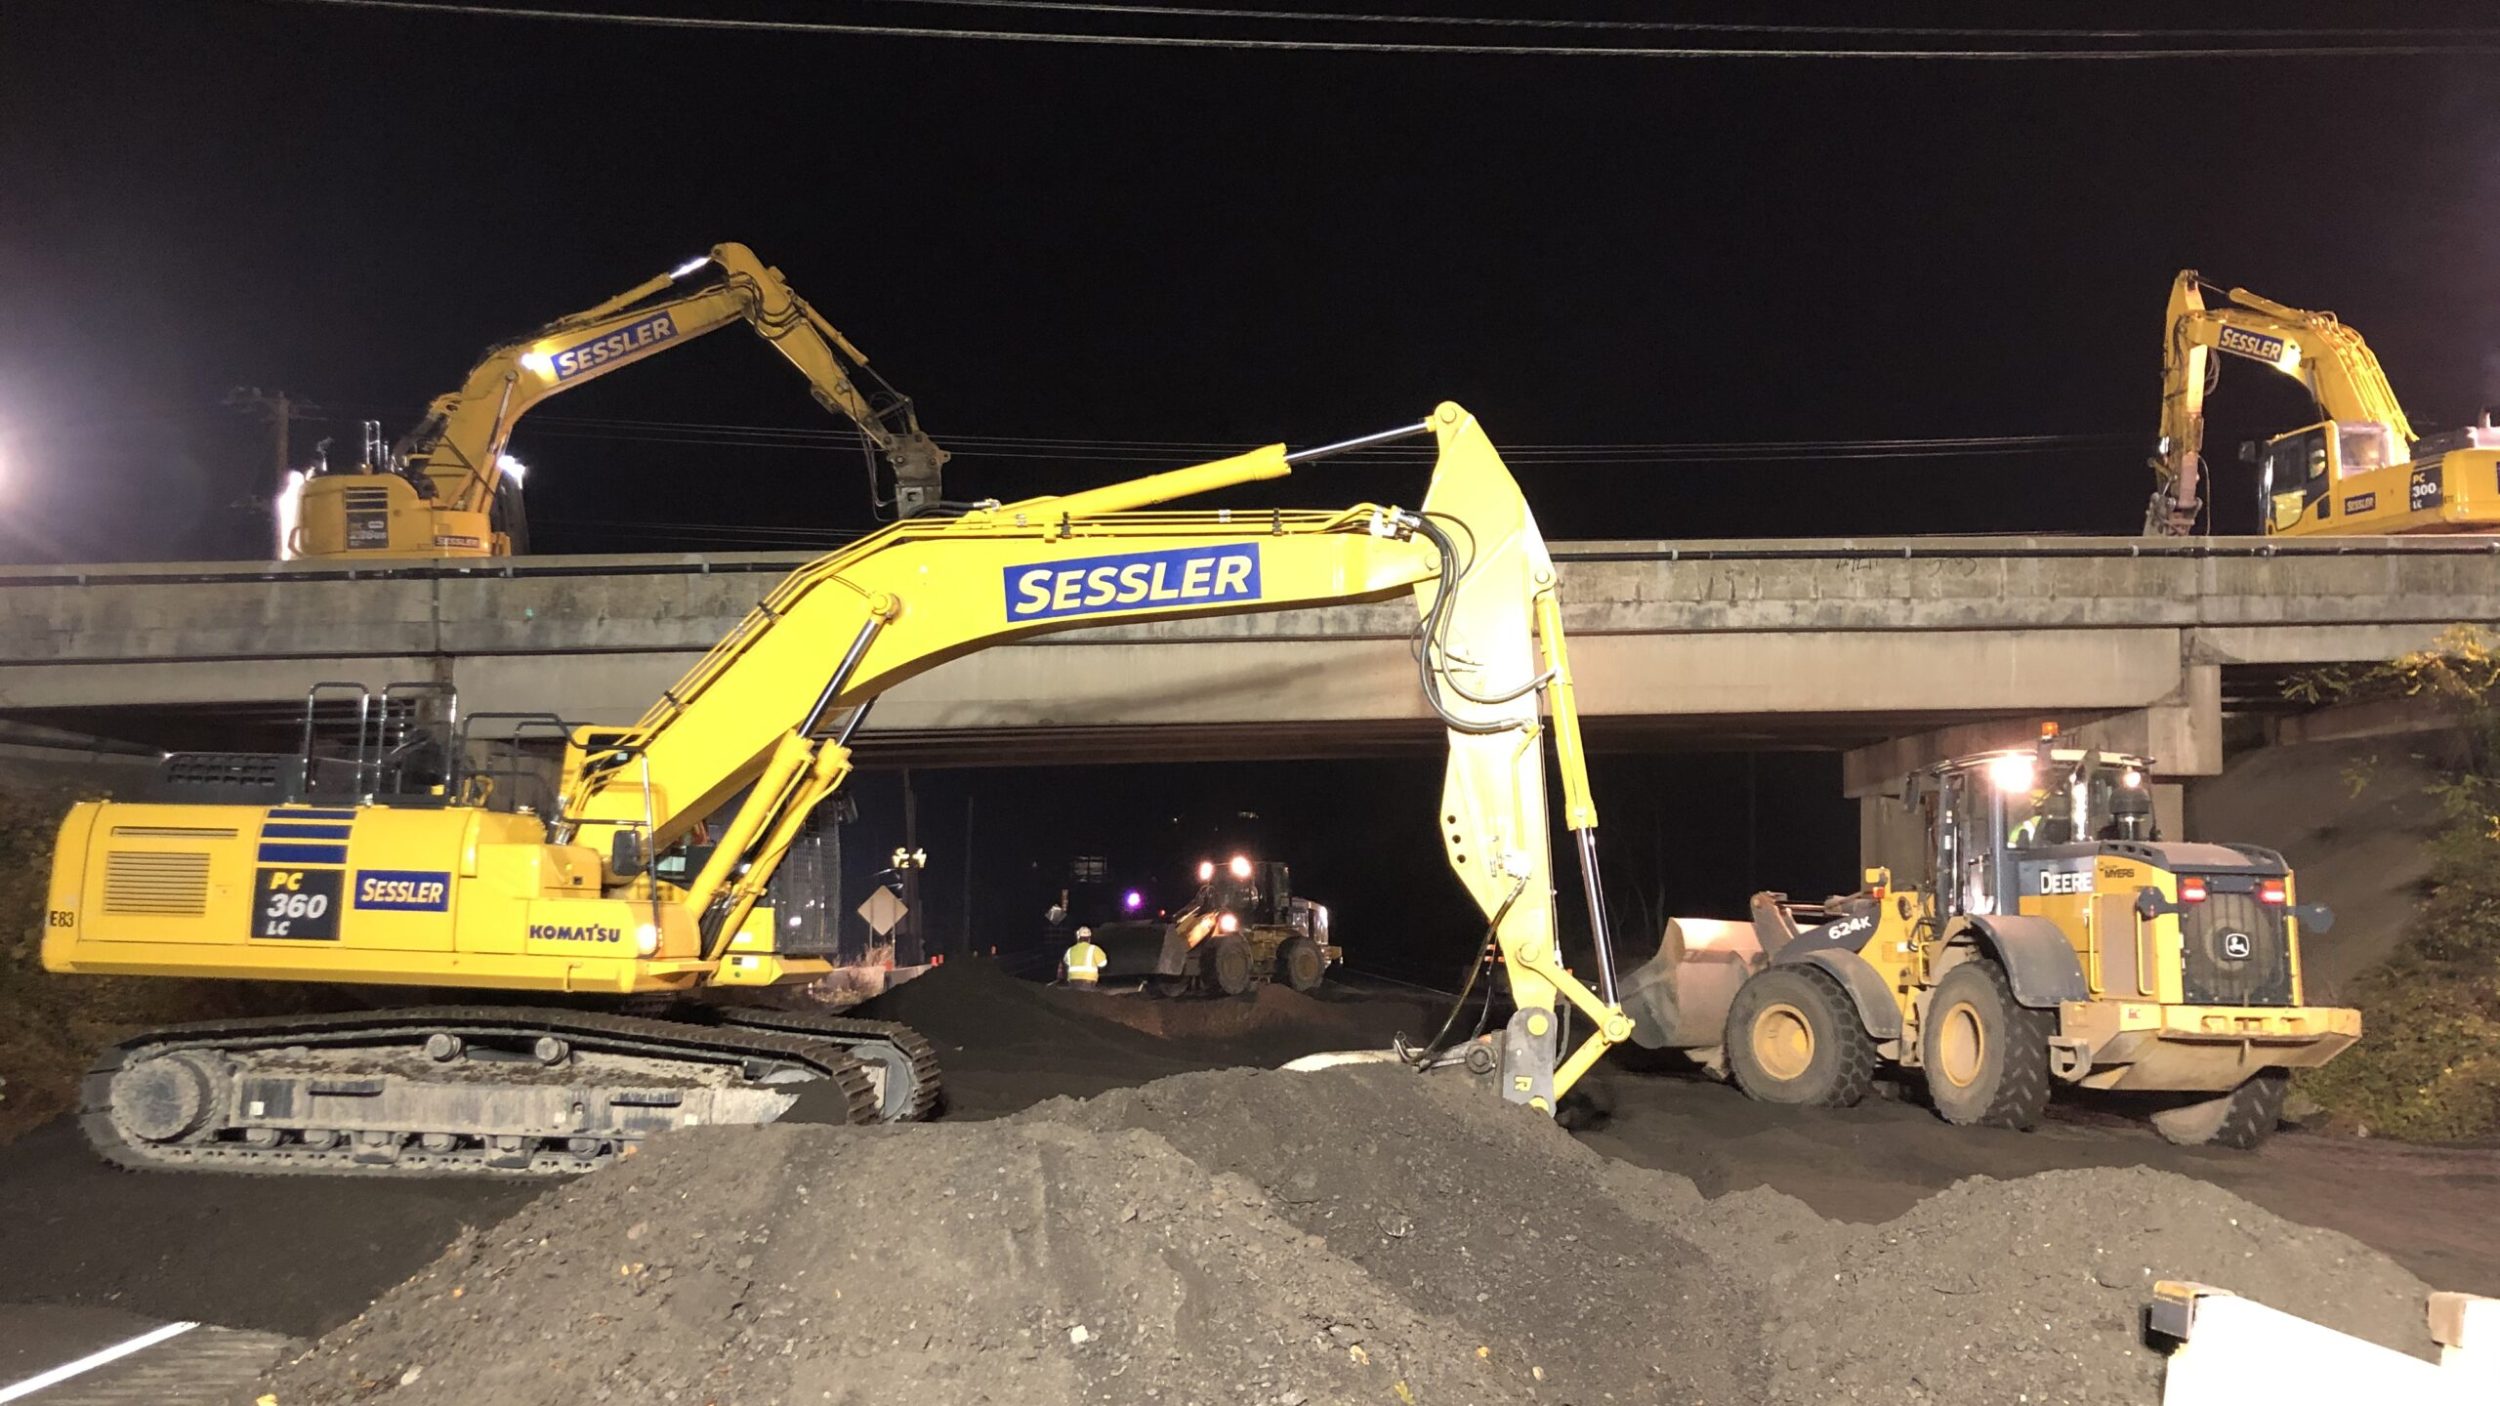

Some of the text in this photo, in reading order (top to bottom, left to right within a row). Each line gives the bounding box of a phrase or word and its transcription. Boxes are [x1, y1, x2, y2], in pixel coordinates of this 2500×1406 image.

[558, 318, 671, 376] SESSLER
[2221, 329, 2281, 360] SESSLER
[2413, 473, 2425, 483] PC
[2412, 482, 2437, 497] 300
[1014, 555, 1252, 614] SESSLER
[269, 872, 303, 890] PC
[2040, 870, 2094, 895] DEERE
[2104, 869, 2135, 879] MYERS
[361, 878, 444, 904] SESSLER
[266, 894, 328, 918] 360
[50, 911, 75, 928] E83
[266, 921, 291, 936] LC
[1828, 916, 1872, 939] 624K
[529, 923, 621, 943] KOMATSU
